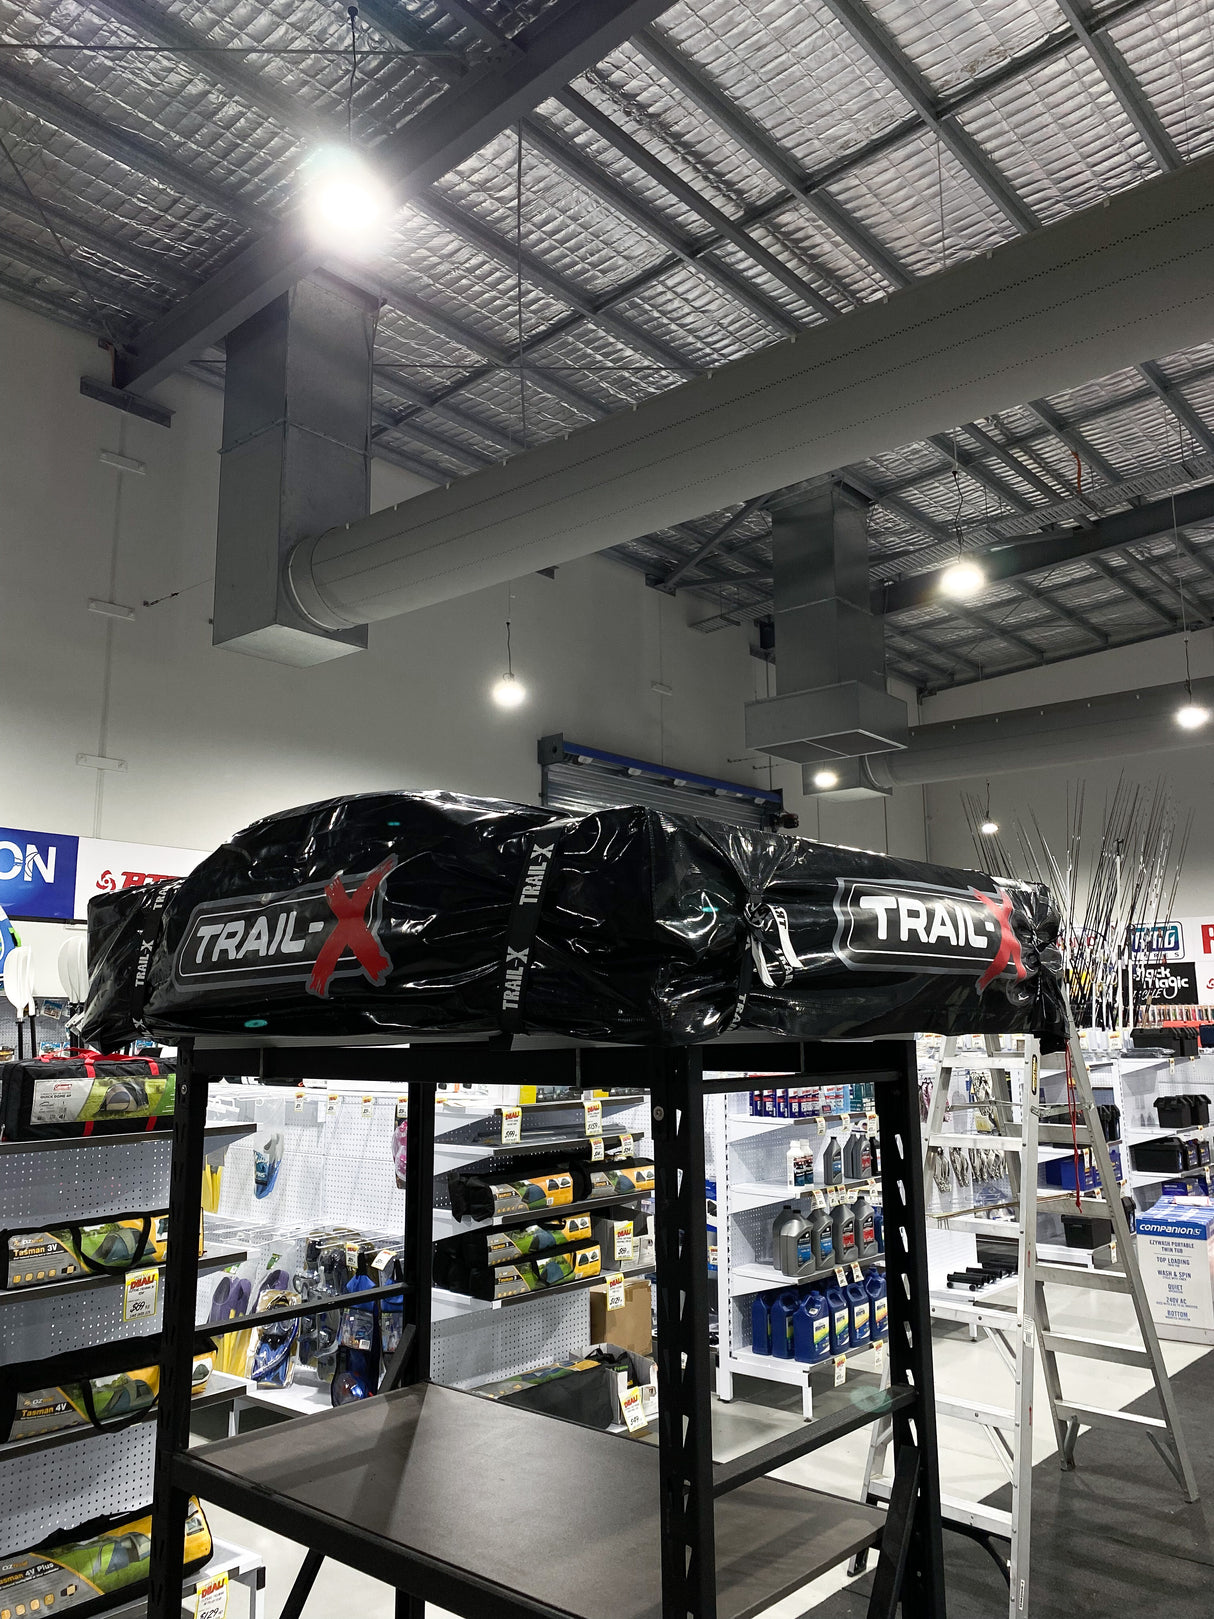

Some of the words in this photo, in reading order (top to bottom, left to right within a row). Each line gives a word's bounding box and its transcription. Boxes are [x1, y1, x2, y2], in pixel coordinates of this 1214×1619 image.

[520, 843, 555, 906] TRAIL-X
[195, 854, 397, 998] TRAIL-X
[859, 887, 1028, 993] TRAIL-X
[134, 939, 155, 988] TRAIL-X
[502, 945, 530, 1011] TRAIL-X
[13, 1246, 46, 1257] Tasman
[1167, 1257, 1190, 1266] LOADING
[1157, 1269, 1173, 1277] WASH
[1178, 1271, 1192, 1279] SPIN
[1167, 1283, 1183, 1291] QUIET
[1167, 1309, 1189, 1318] BOTTOM
[22, 1406, 54, 1418] Tasman
[55, 1402, 67, 1412] 4V
[25, 1567, 36, 1577] 4V
[36, 1561, 55, 1573] Plus
[201, 1577, 226, 1599] DEAL!
